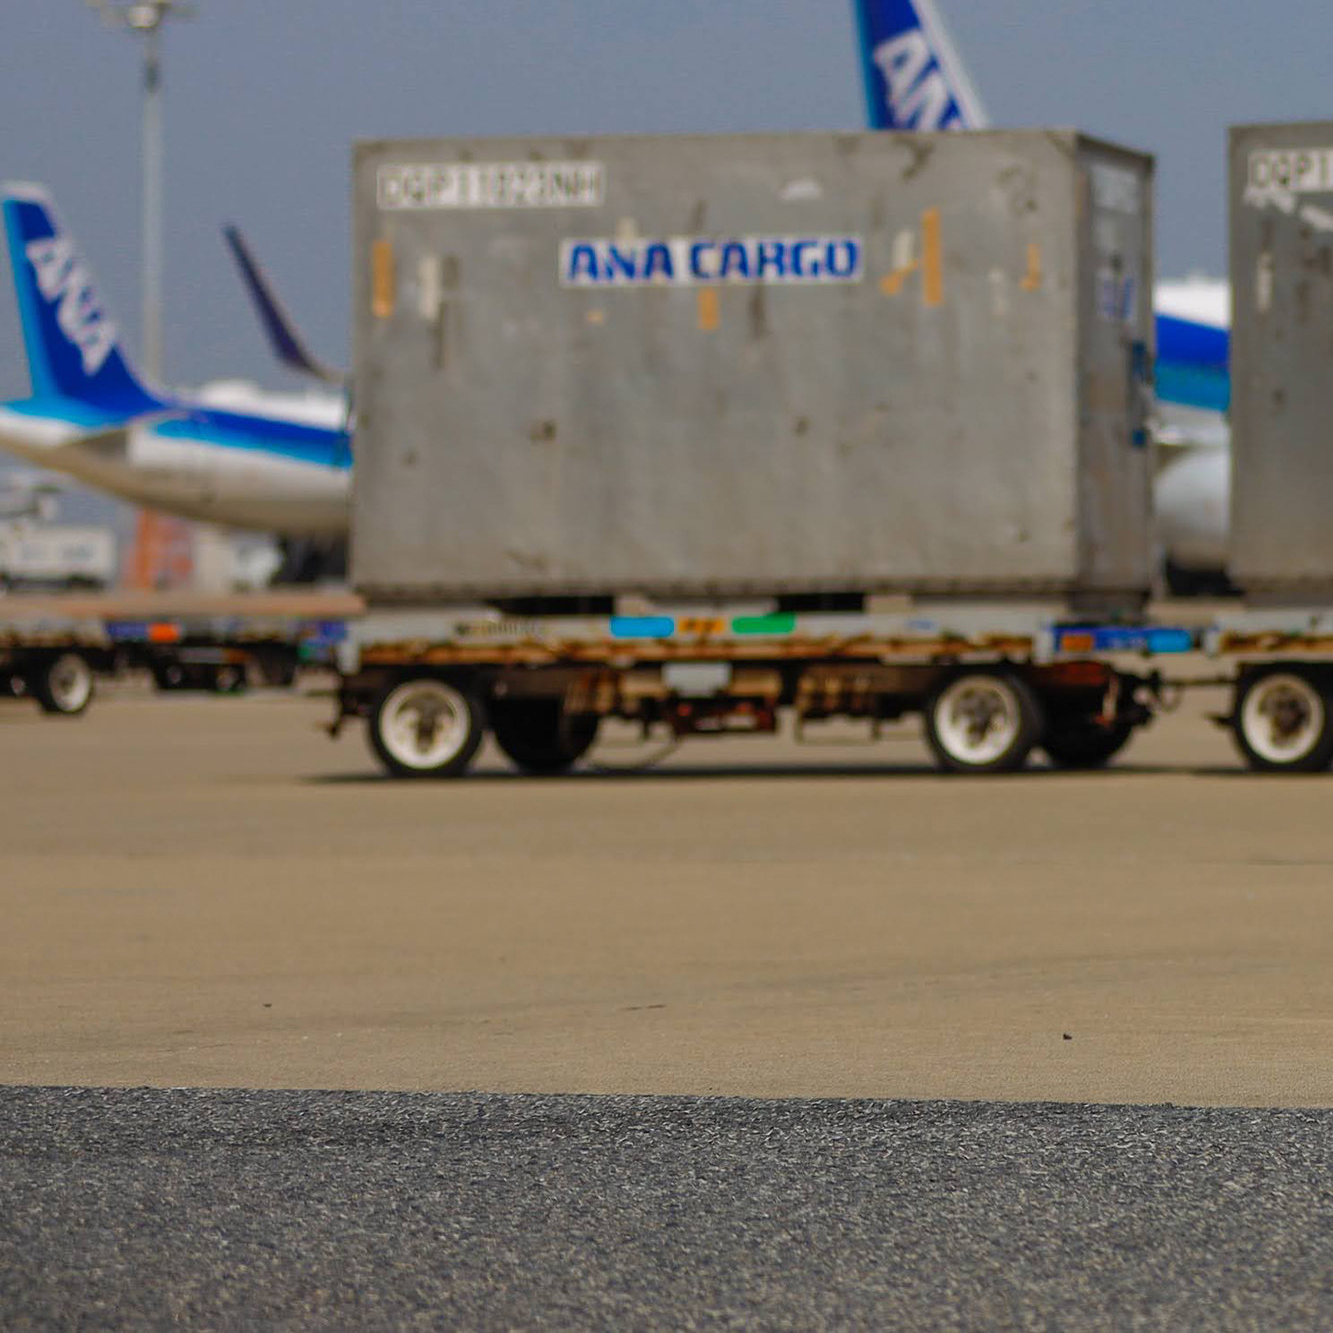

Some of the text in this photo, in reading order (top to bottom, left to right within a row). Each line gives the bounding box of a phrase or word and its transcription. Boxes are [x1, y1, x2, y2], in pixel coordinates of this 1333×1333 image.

[874, 30, 962, 129] AN
[25, 237, 116, 376] ANA
[569, 241, 857, 279] ANA CARGO
